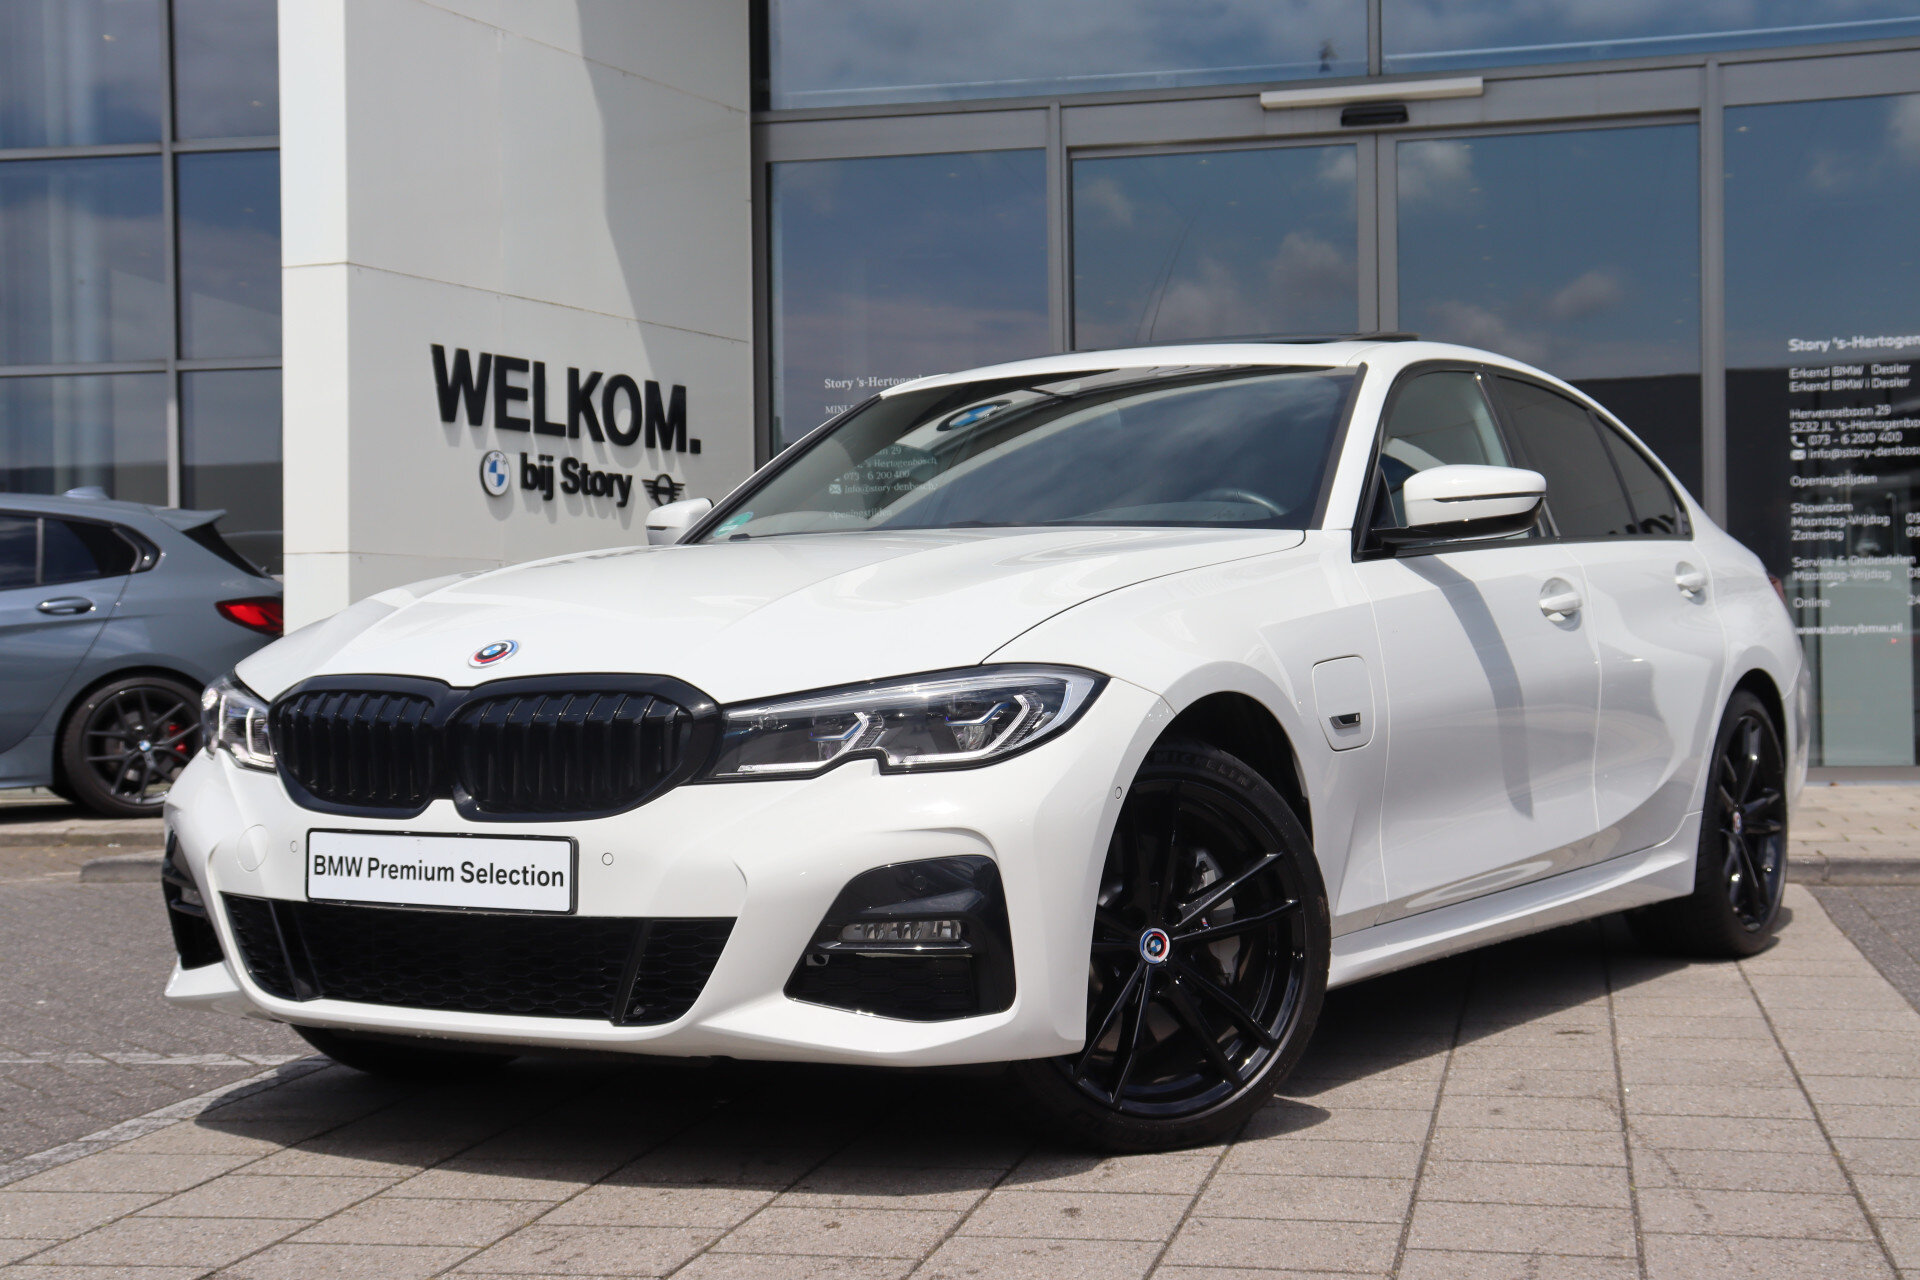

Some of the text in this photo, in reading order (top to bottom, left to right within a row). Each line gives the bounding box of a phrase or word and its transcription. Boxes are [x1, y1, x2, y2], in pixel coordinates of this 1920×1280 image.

[1788, 339, 1830, 352] Story
[1789, 364, 1910, 379] Erkend BMW Dealer
[824, 378, 854, 391] Story
[1789, 381, 1830, 392] Erkend
[1832, 379, 1864, 390] BMW
[1871, 378, 1910, 389] Dealer
[430, 343, 702, 454] WELKOM.
[1874, 404, 1891, 415] 29
[1790, 422, 1819, 432] 5232
[1808, 435, 1830, 444] 073
[1840, 434, 1850, 444] 6
[1851, 433, 1875, 444] 200
[1878, 432, 1902, 442] 400
[520, 452, 633, 508] bij Story
[1792, 557, 1834, 568] Service
[1793, 598, 1830, 607] Online
[313, 855, 565, 888] BMW Premium Selection
